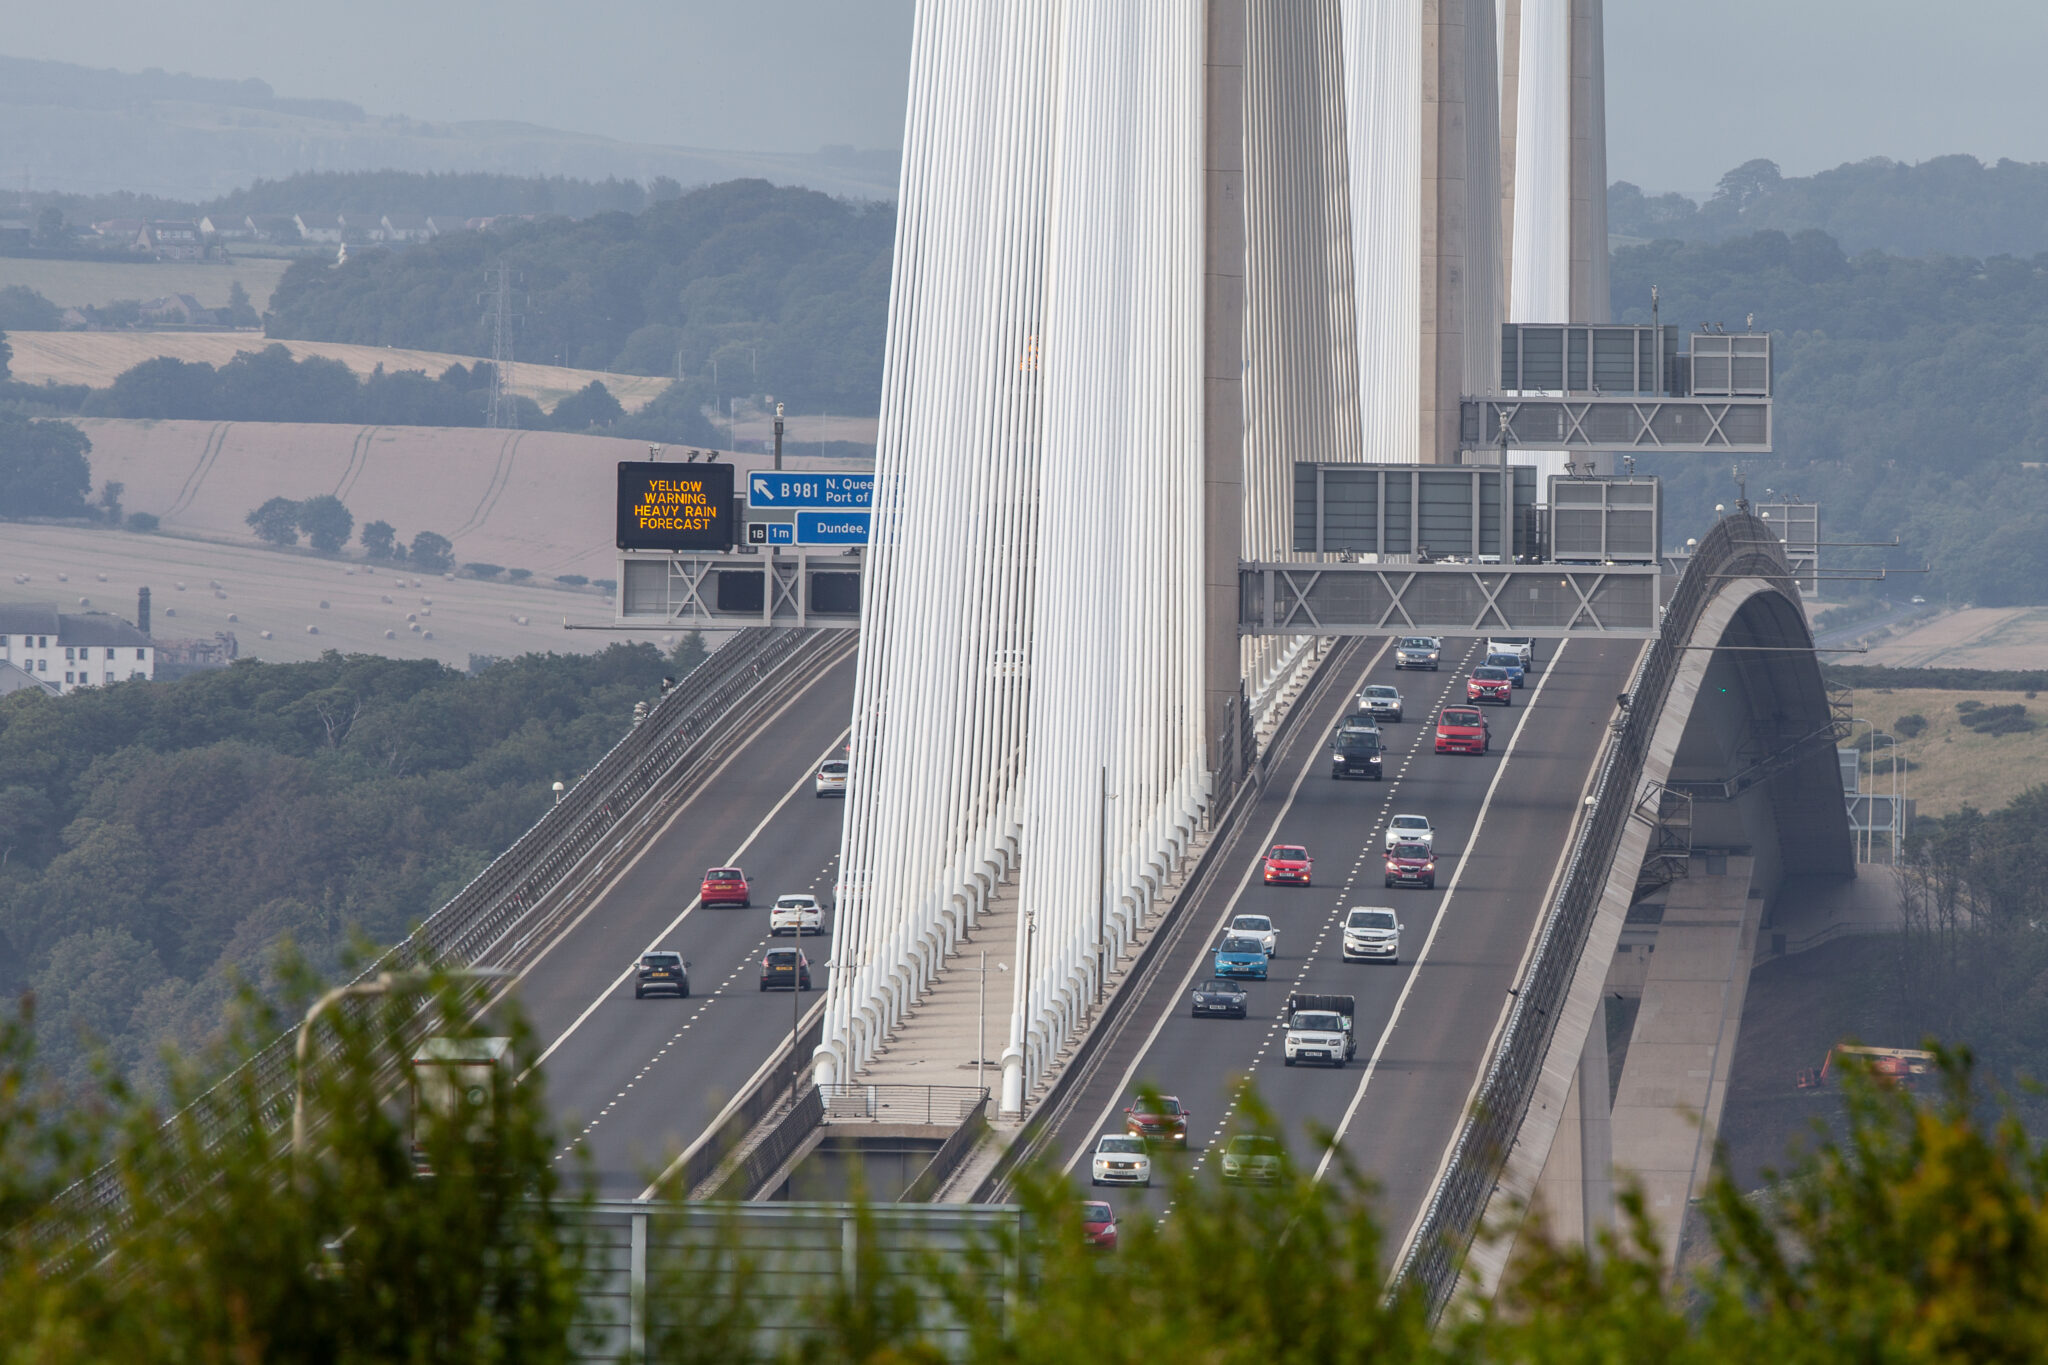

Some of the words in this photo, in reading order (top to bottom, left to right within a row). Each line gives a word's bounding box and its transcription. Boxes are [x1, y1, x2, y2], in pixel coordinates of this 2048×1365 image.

[649, 480, 702, 492] YELLOW
[793, 483, 818, 498] 981
[644, 493, 707, 504] WARNING
[826, 492, 852, 503] Port
[855, 492, 869, 503] of
[634, 505, 679, 517] HEAVY
[685, 506, 717, 518] RAIN
[639, 518, 711, 530] FORECAST
[751, 529, 764, 539] 1B
